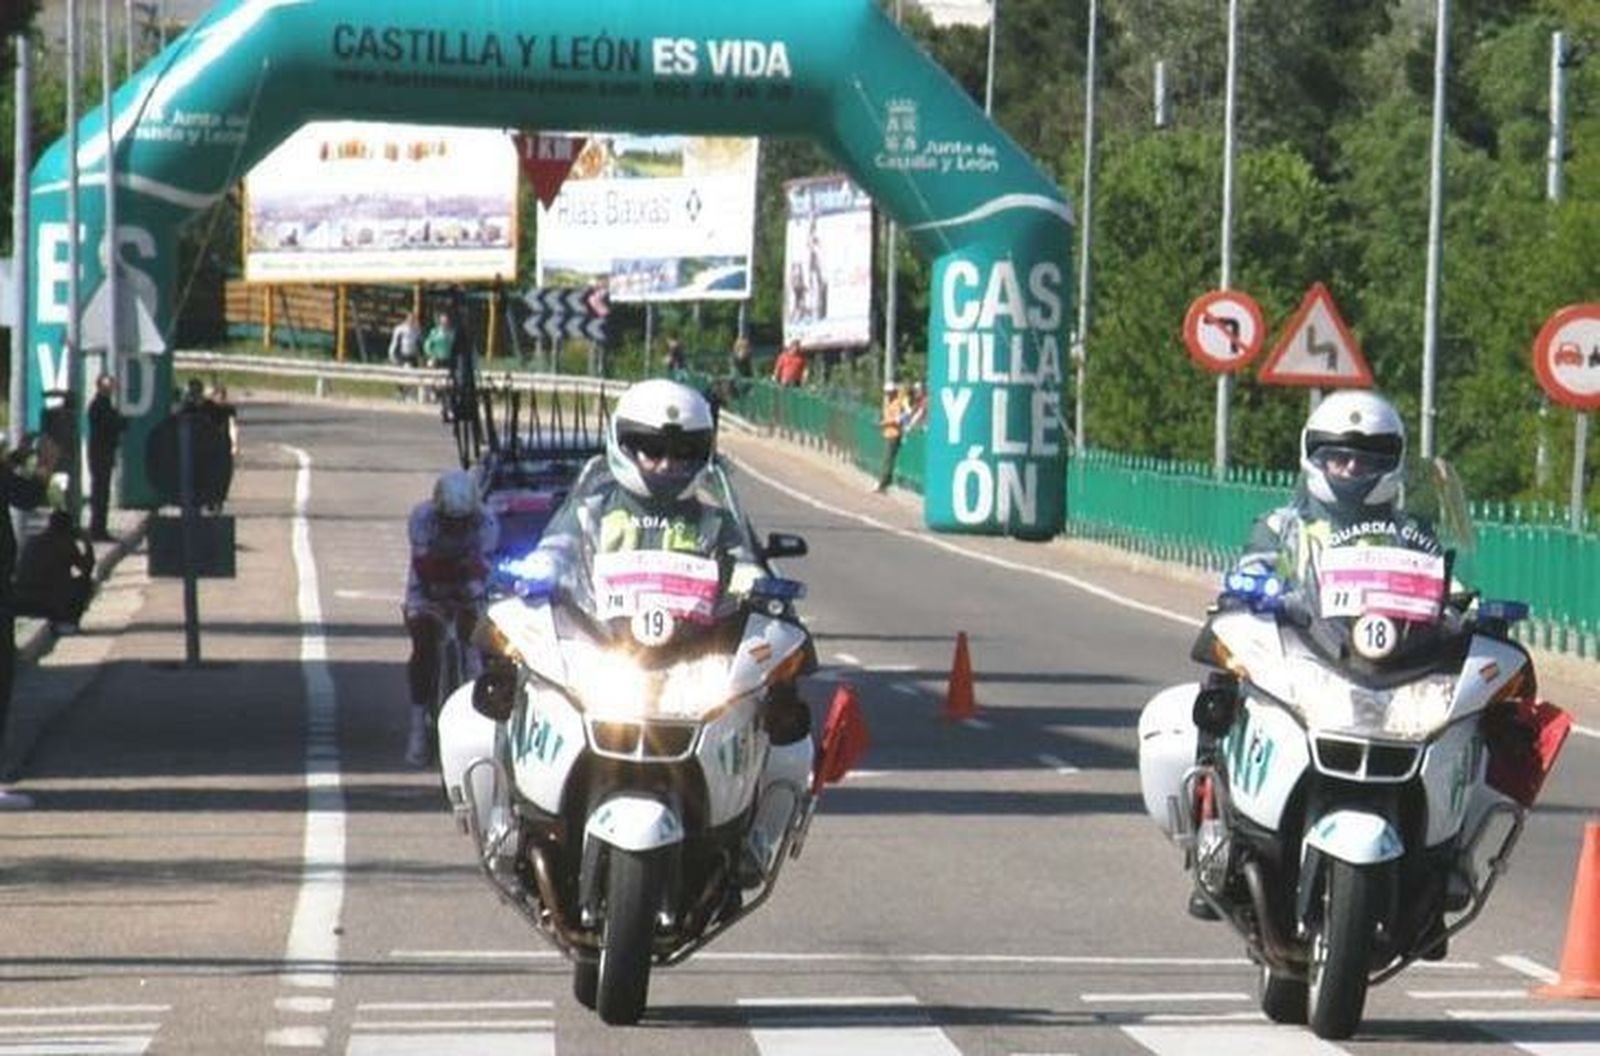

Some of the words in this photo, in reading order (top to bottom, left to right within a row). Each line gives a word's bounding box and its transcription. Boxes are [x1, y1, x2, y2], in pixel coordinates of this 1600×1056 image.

[333, 24, 504, 68] CASTILLA
[517, 35, 538, 68] Y
[550, 30, 641, 72] LEÓN
[652, 38, 699, 75] ES
[708, 40, 791, 78] VIDA
[922, 140, 973, 157] Junta
[940, 157, 952, 174] y
[957, 155, 999, 173] León
[942, 260, 1062, 330] CAS
[943, 332, 1062, 384] TILLA
[940, 387, 972, 445] Y
[991, 387, 1059, 456] LE
[952, 445, 1038, 525] ÓN
[1331, 521, 1396, 547] GUARDIA
[1401, 526, 1439, 555] CIVIL
[644, 610, 664, 637] 19
[1364, 621, 1386, 649] 18
